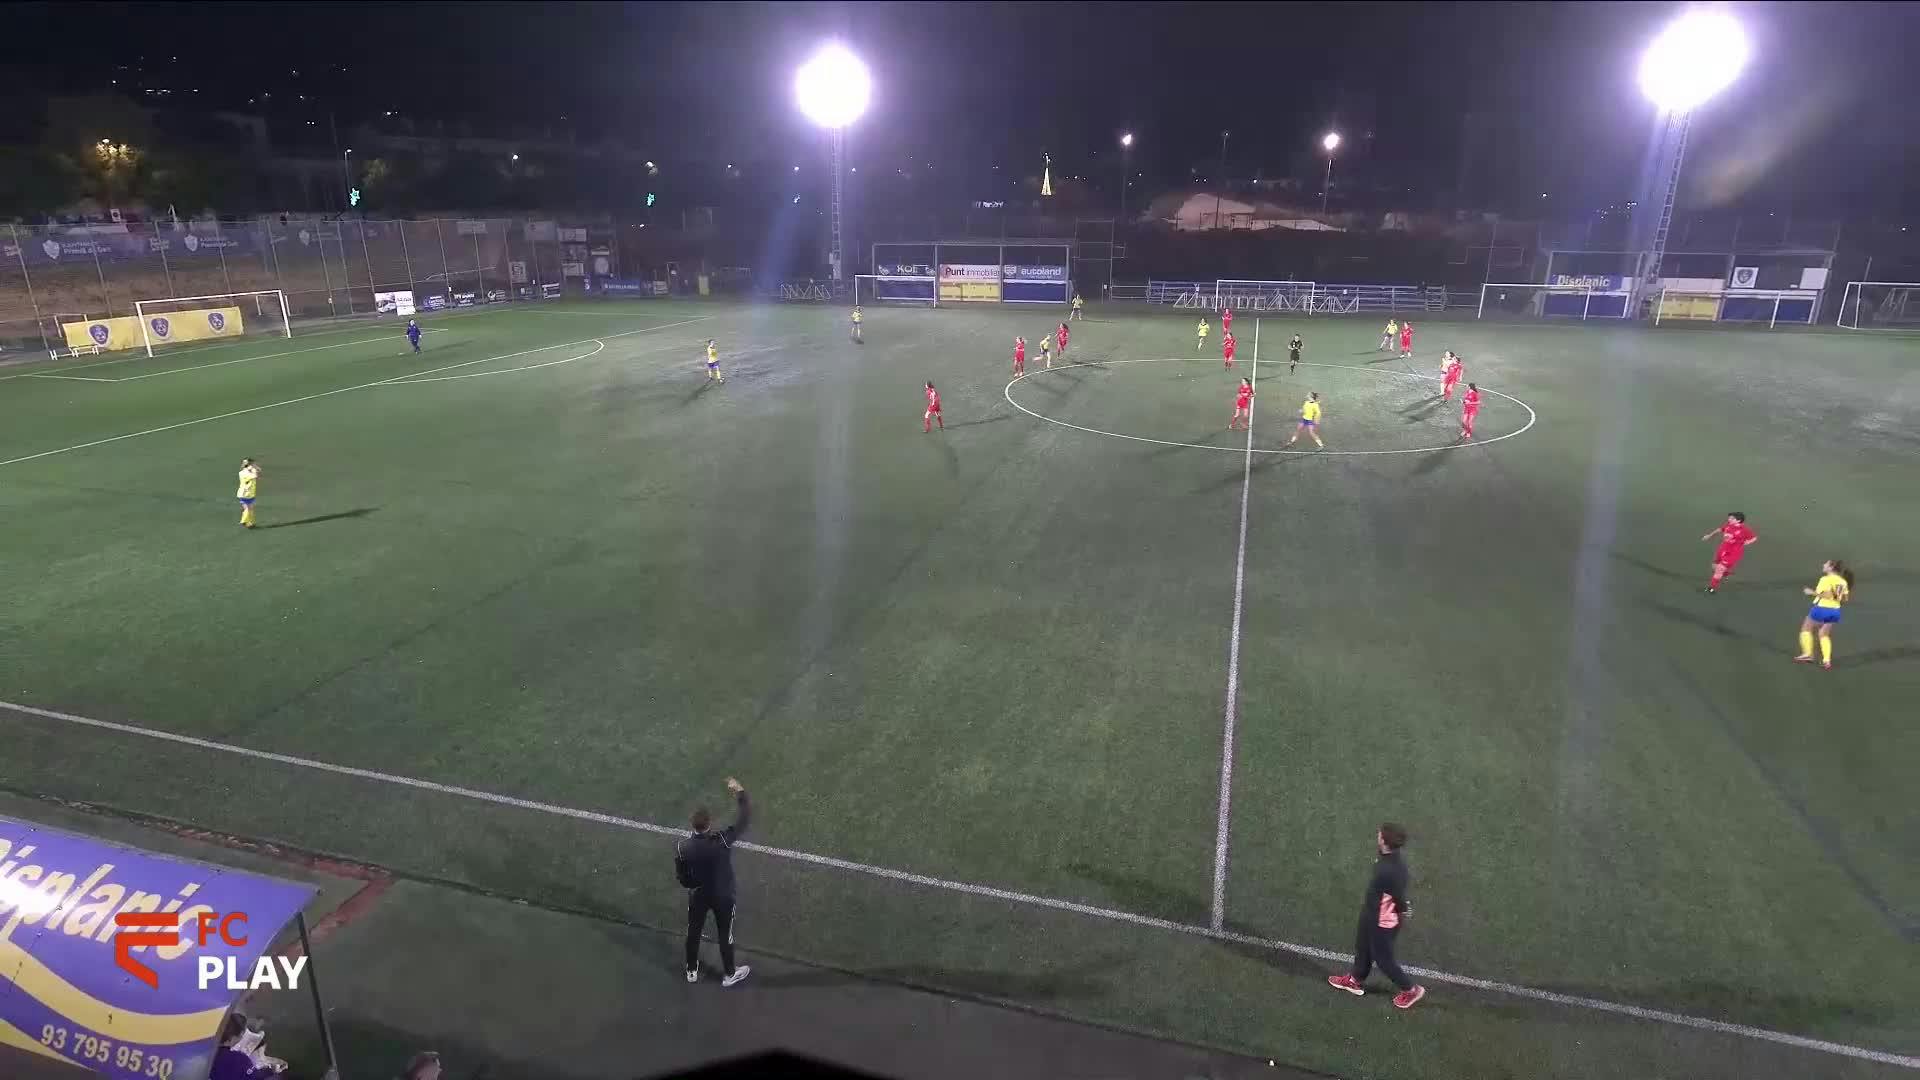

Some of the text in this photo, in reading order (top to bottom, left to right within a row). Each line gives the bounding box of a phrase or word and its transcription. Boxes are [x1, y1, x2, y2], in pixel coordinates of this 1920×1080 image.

[945, 267, 965, 276] Punt
[1021, 267, 1062, 276] autoland
[1557, 274, 1610, 287] Displanic
[41, 1023, 173, 1080] 93 795 95 30
